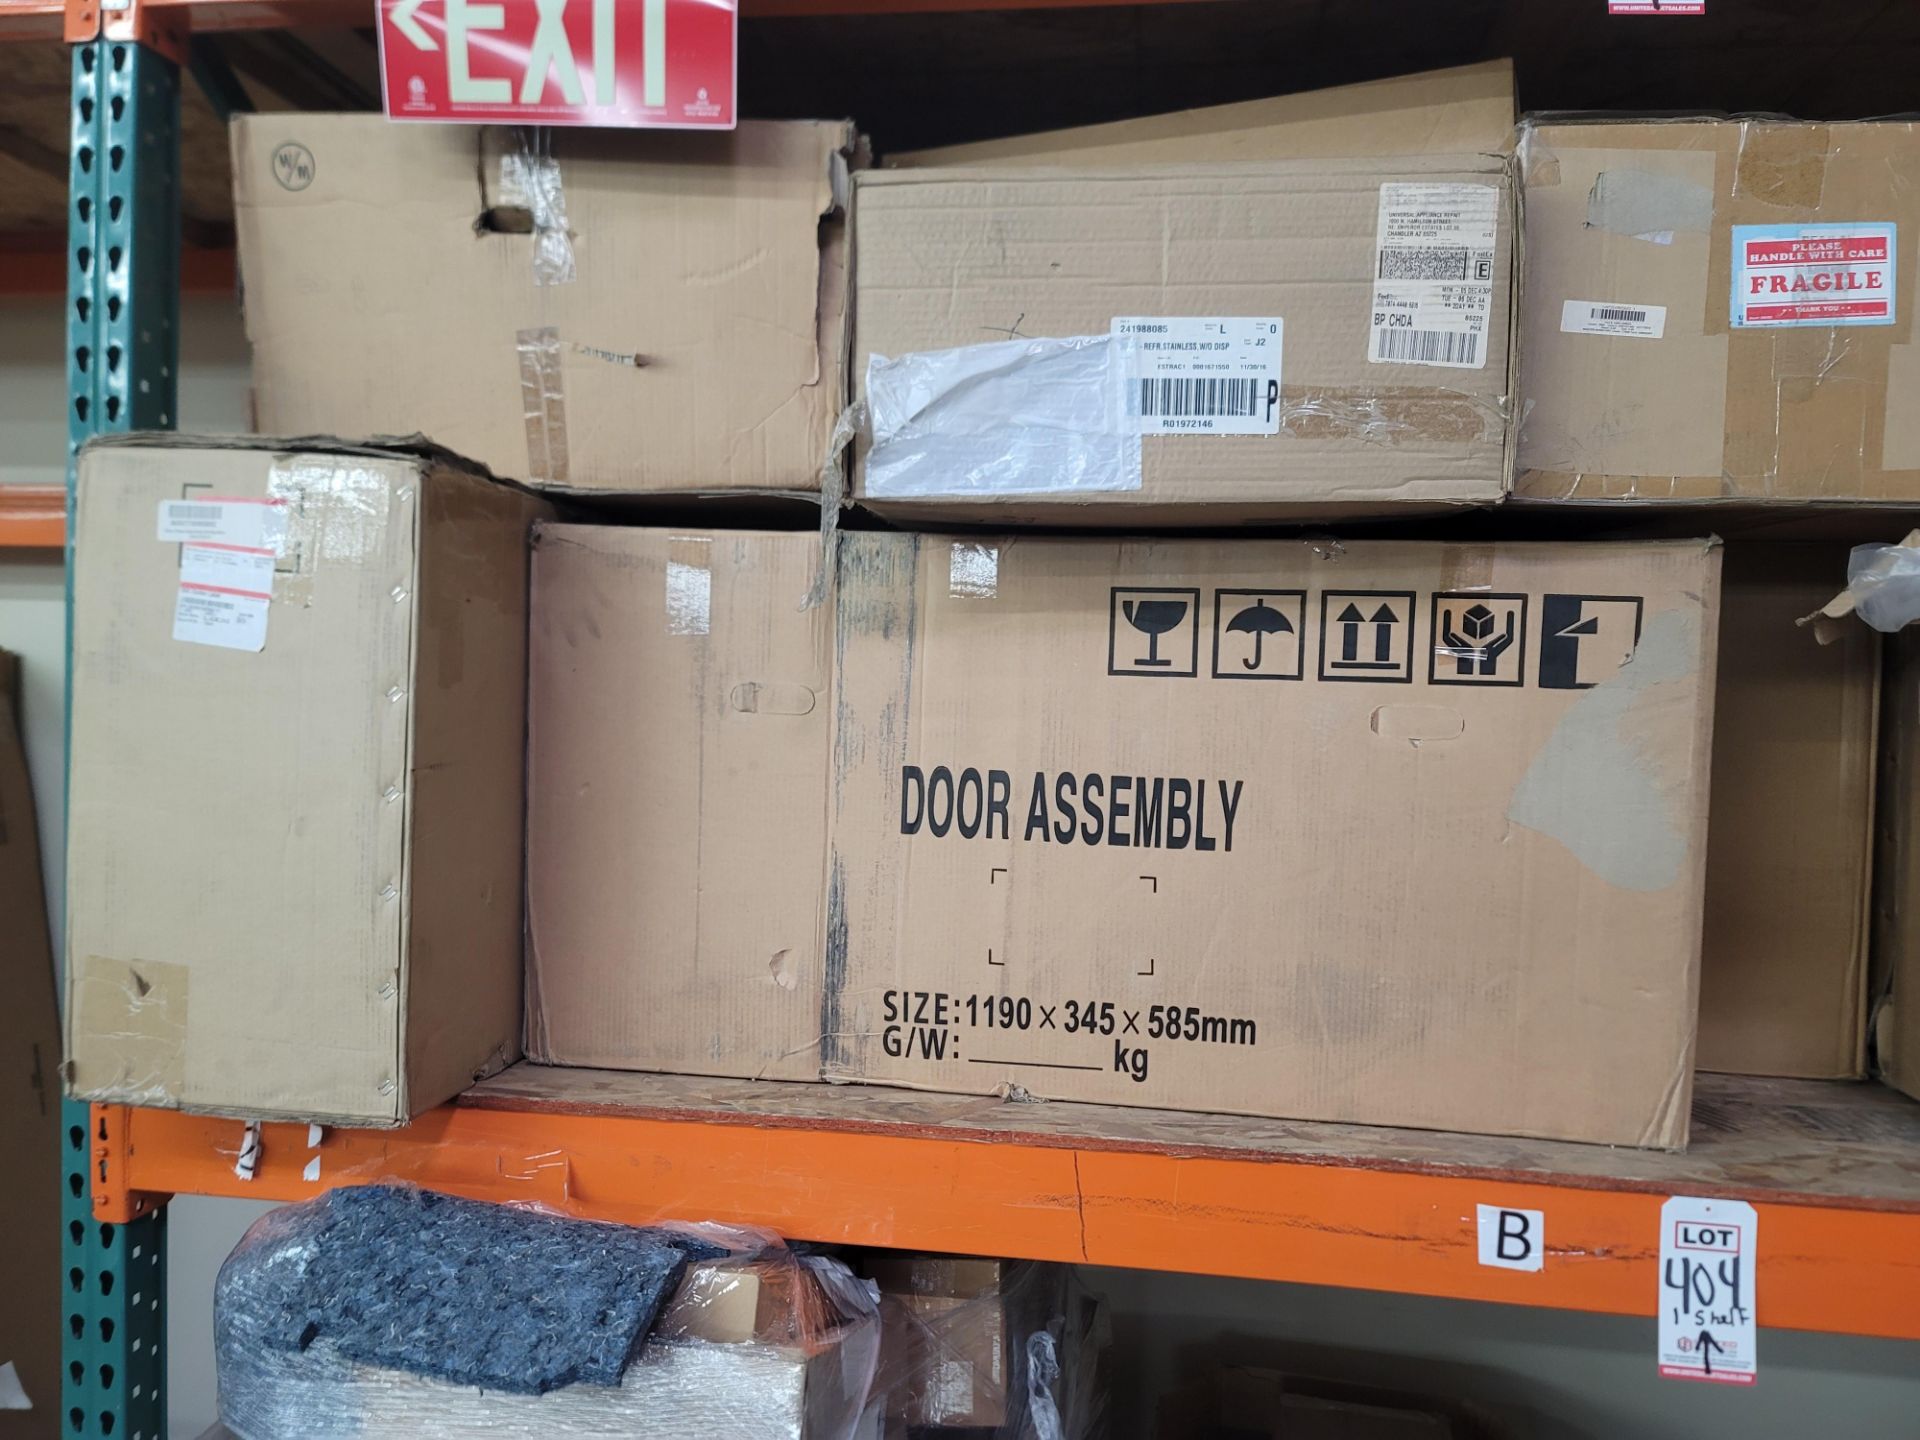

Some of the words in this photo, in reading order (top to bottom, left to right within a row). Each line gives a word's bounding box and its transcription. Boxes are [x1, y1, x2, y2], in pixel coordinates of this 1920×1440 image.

[1792, 241, 1842, 252] PLEASE
[1750, 251, 1804, 263] HANDLE
[1808, 250, 1845, 260] WITH
[1848, 248, 1884, 259] CARE
[1478, 262, 1488, 278] E
[1750, 271, 1883, 294] FRAGILE
[1374, 313, 1385, 326] BP
[1389, 313, 1413, 327] CHDA
[1120, 325, 1168, 333] 241988085
[1220, 324, 1226, 334] L
[1255, 338, 1266, 346] J2
[1266, 379, 1278, 423] P
[1162, 420, 1213, 428] R01972146
[900, 765, 1011, 840] DOOR
[1024, 771, 1244, 852] ASSEMBLY
[1063, 999, 1116, 1035] 345
[1148, 1005, 1257, 1045] 585mm
[883, 1025, 959, 1060] G/W:
[1114, 1039, 1149, 1082] kg
[1496, 1210, 1532, 1261] B
[1683, 1227, 1733, 1246] LOT
[1665, 1255, 1740, 1314] 404
